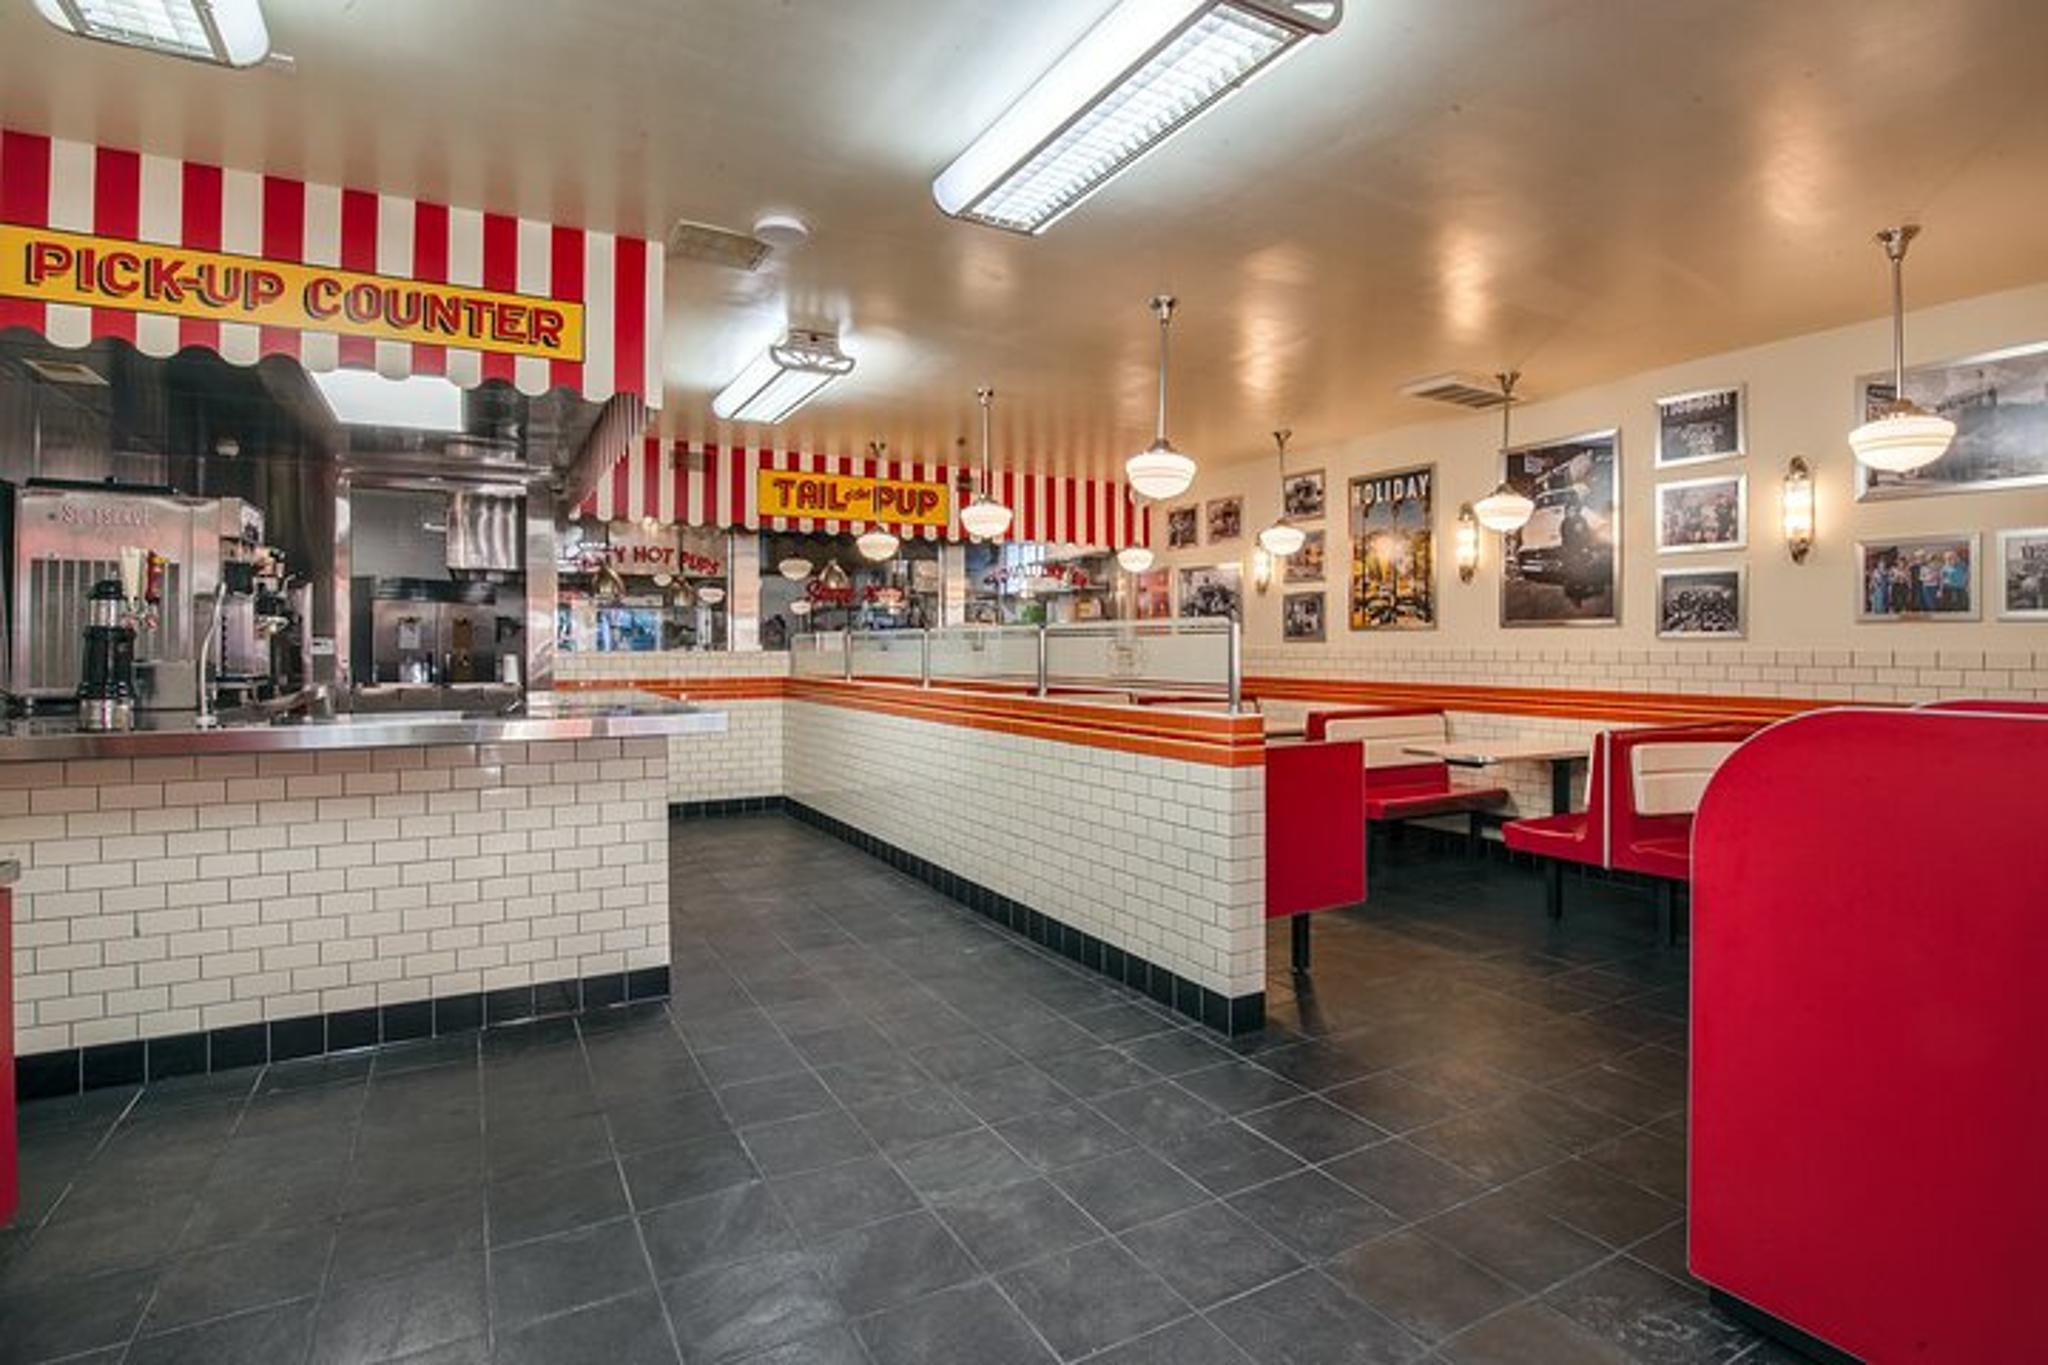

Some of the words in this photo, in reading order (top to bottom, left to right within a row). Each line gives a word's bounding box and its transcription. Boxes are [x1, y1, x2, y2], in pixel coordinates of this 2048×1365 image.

[25, 239, 286, 310] PICK-UP
[303, 275, 565, 348] COUNTER
[773, 478, 848, 511] TAIL
[873, 486, 939, 518] PUP
[633, 546, 675, 564] HOT
